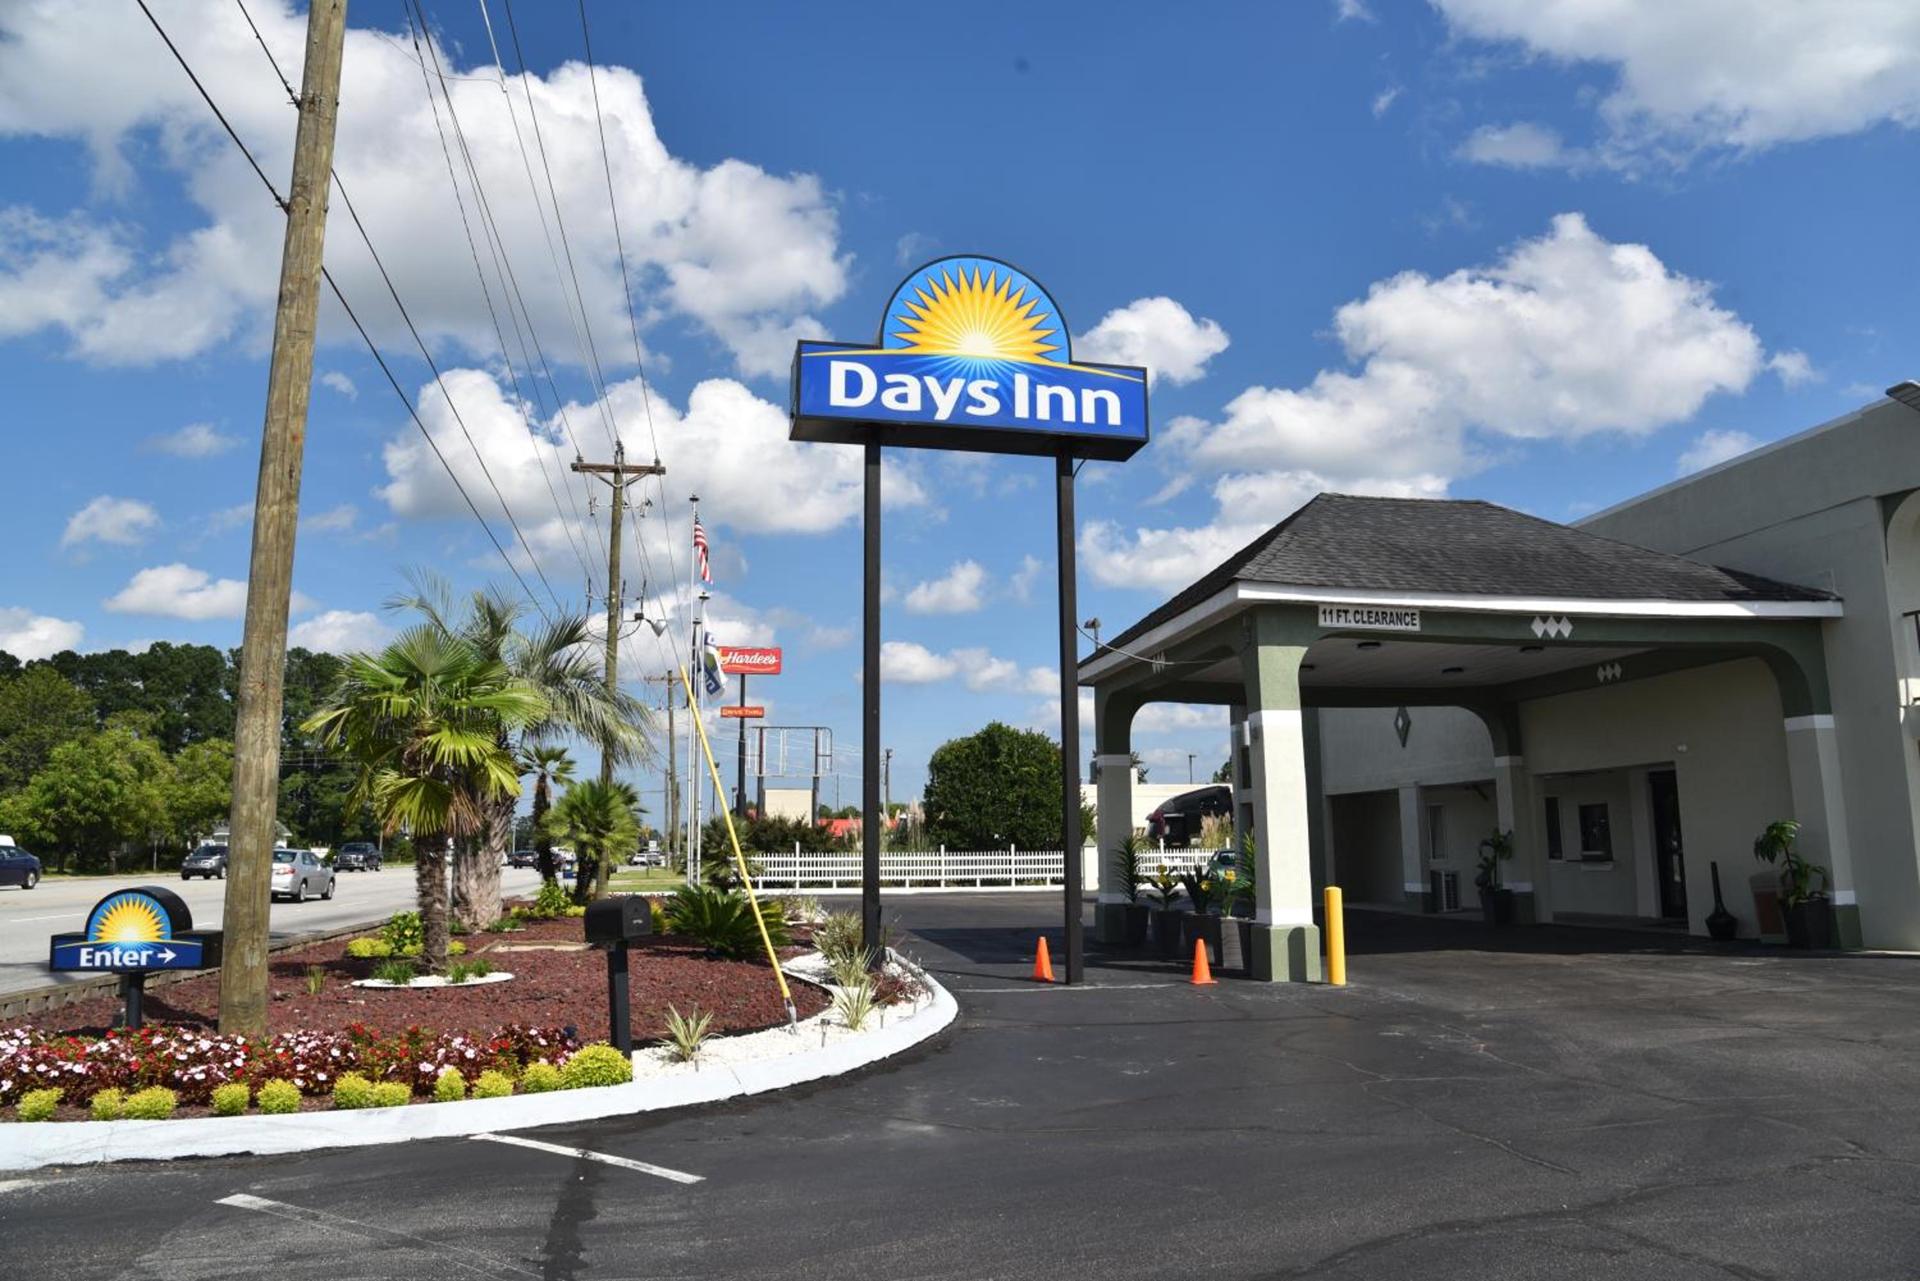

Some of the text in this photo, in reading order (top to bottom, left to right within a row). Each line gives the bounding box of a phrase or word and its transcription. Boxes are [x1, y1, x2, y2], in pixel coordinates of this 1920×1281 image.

[830, 360, 1121, 425] Days Inn
[1321, 608, 1417, 627] 11 FT. CLEARANCE
[79, 947, 153, 967] Enter
